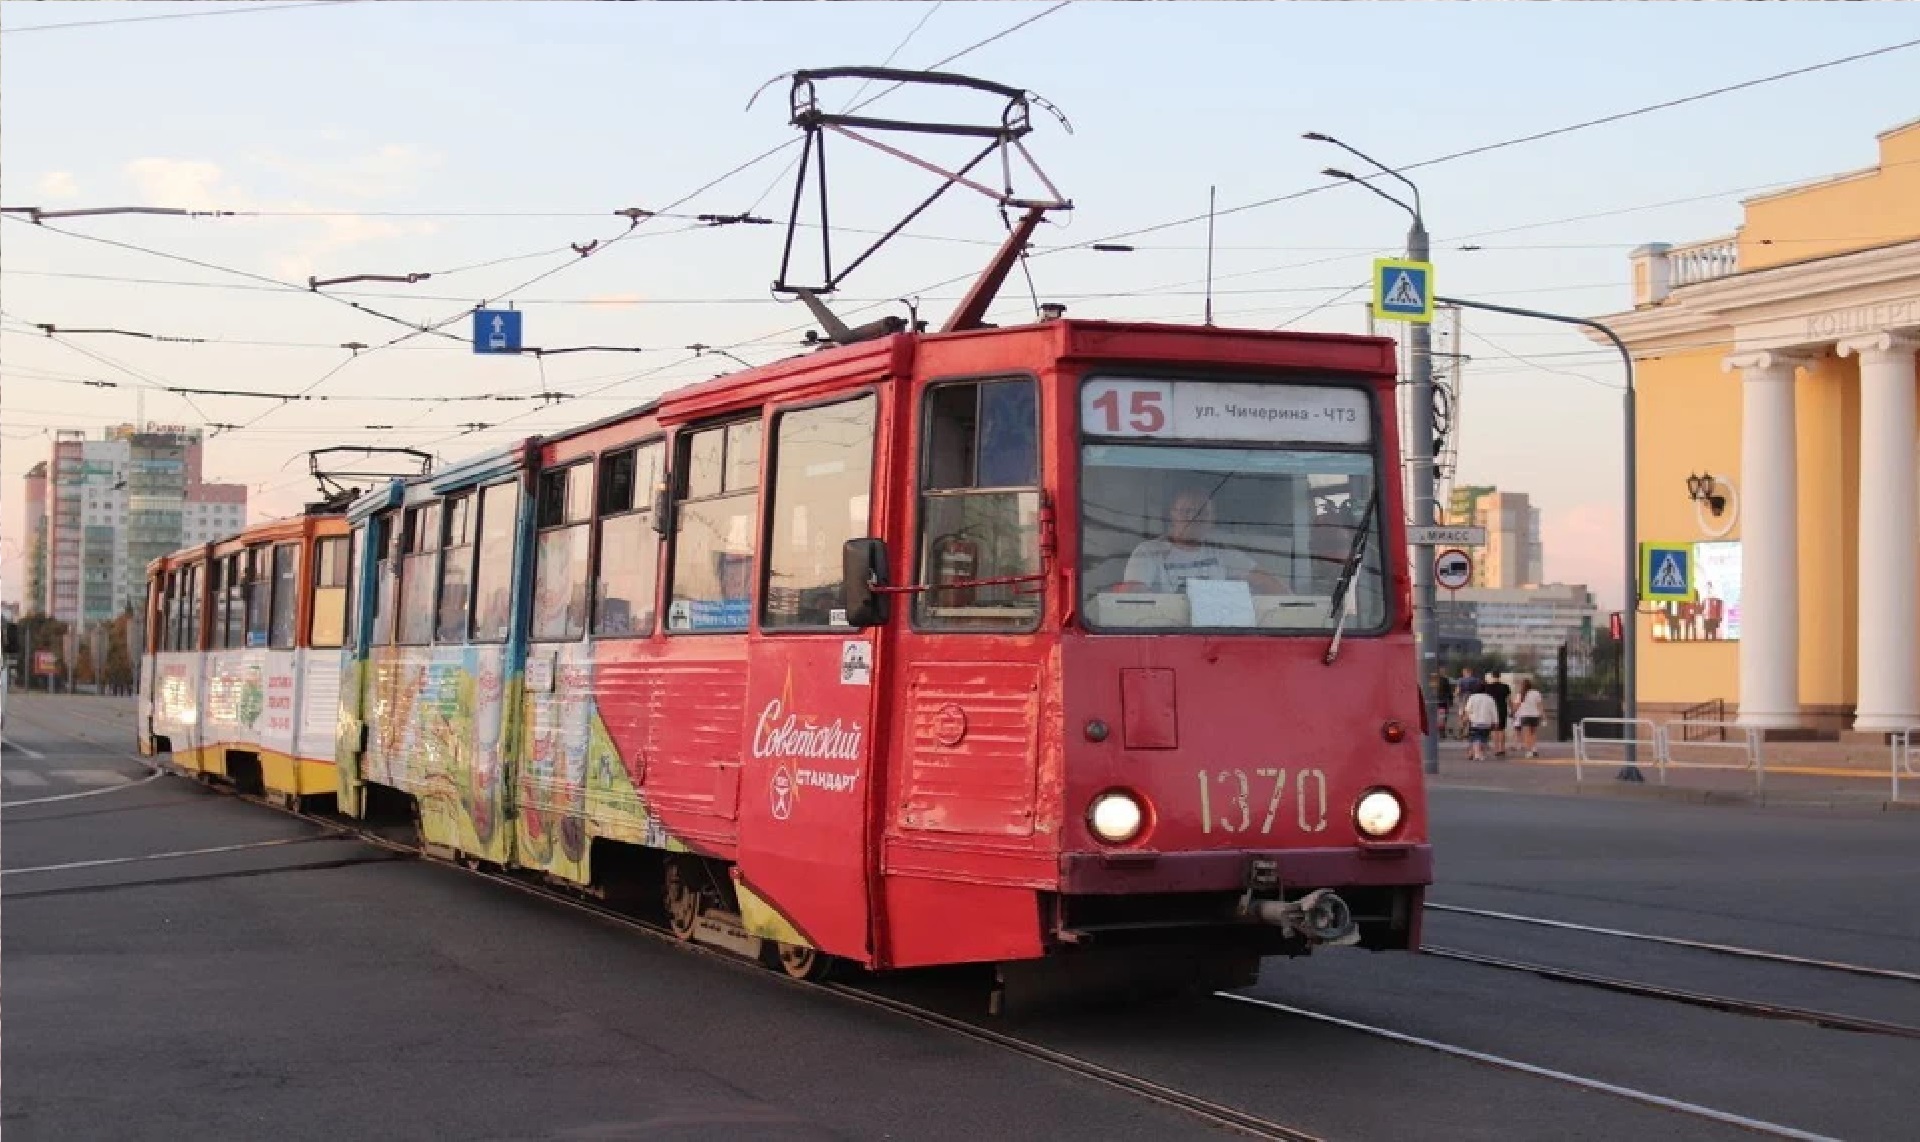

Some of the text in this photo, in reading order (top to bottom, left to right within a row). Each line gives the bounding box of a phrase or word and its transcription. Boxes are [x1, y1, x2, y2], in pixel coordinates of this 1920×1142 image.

[1092, 390, 1165, 433] 15
[1195, 405, 1220, 419] ул.
[1224, 404, 1310, 422] Чичерина
[1427, 530, 1470, 541] МИАСС
[753, 699, 861, 760] Советский
[796, 769, 859, 792] СТАНДАРТ
[1198, 769, 1328, 834] 1370
